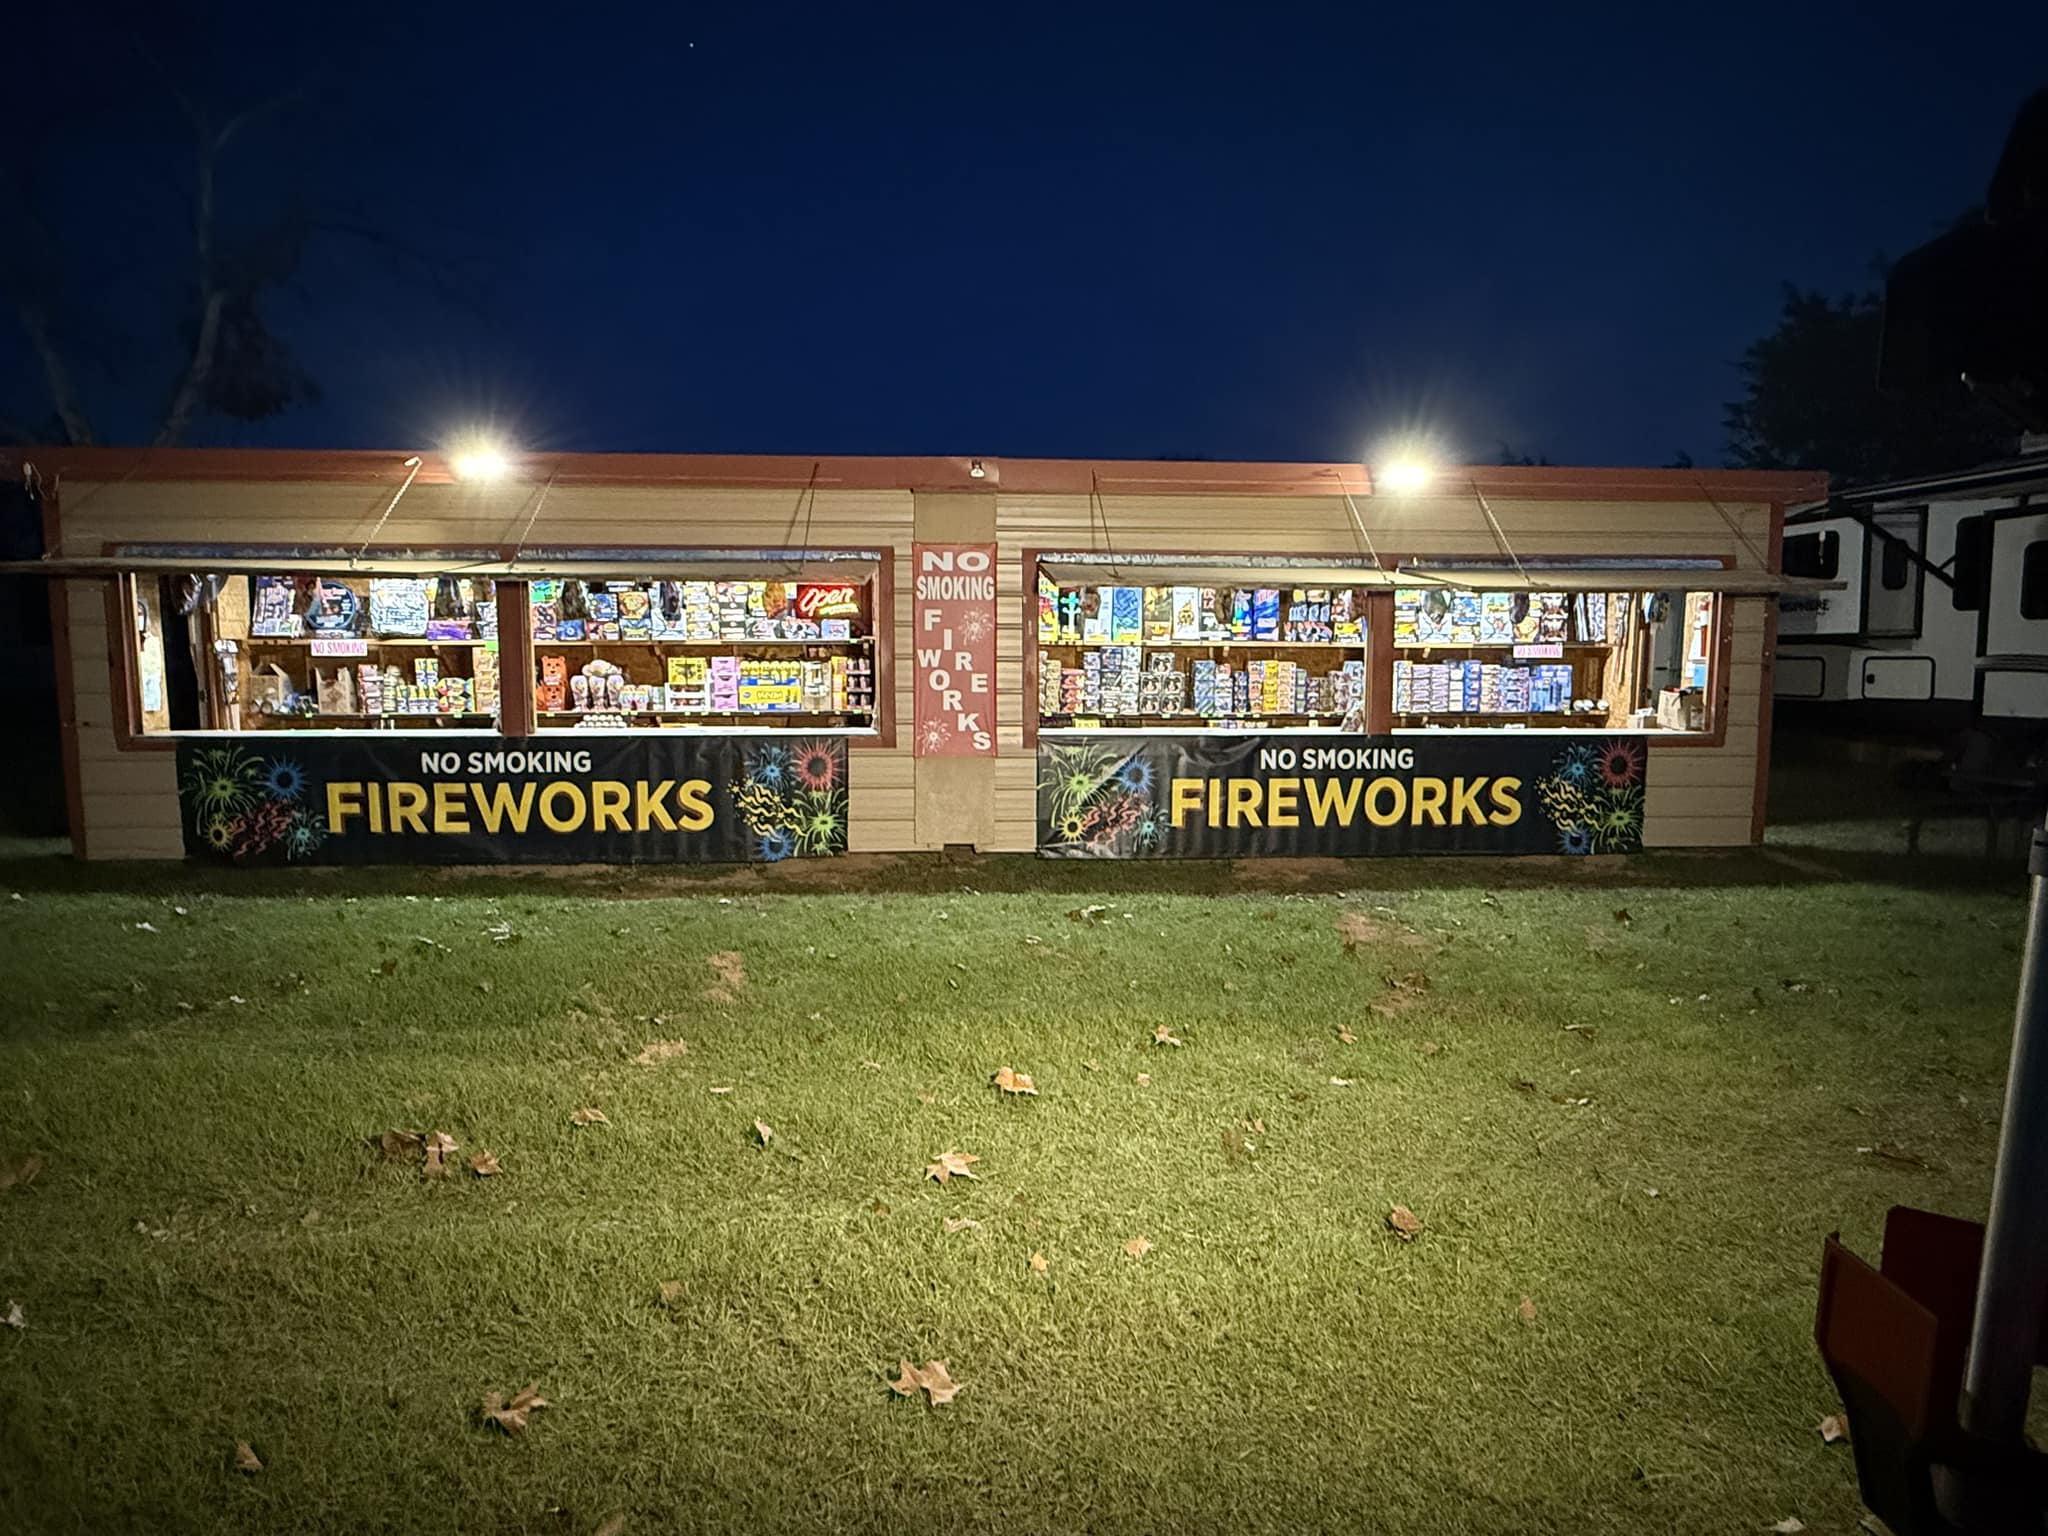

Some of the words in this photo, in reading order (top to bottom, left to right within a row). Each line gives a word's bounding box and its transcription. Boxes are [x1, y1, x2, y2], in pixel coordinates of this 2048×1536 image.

[922, 551, 990, 572] NO
[916, 575, 995, 601] SMOKING
[801, 588, 855, 617] Open
[313, 641, 325, 654] NO
[327, 641, 365, 654] SMOKING
[421, 751, 461, 775] NO
[467, 750, 592, 774] SMOKING
[1260, 748, 1296, 770] NO
[1302, 747, 1414, 770] SMOKING
[326, 779, 715, 834] FIREWORKS
[1171, 776, 1522, 829] FIREWORKS
